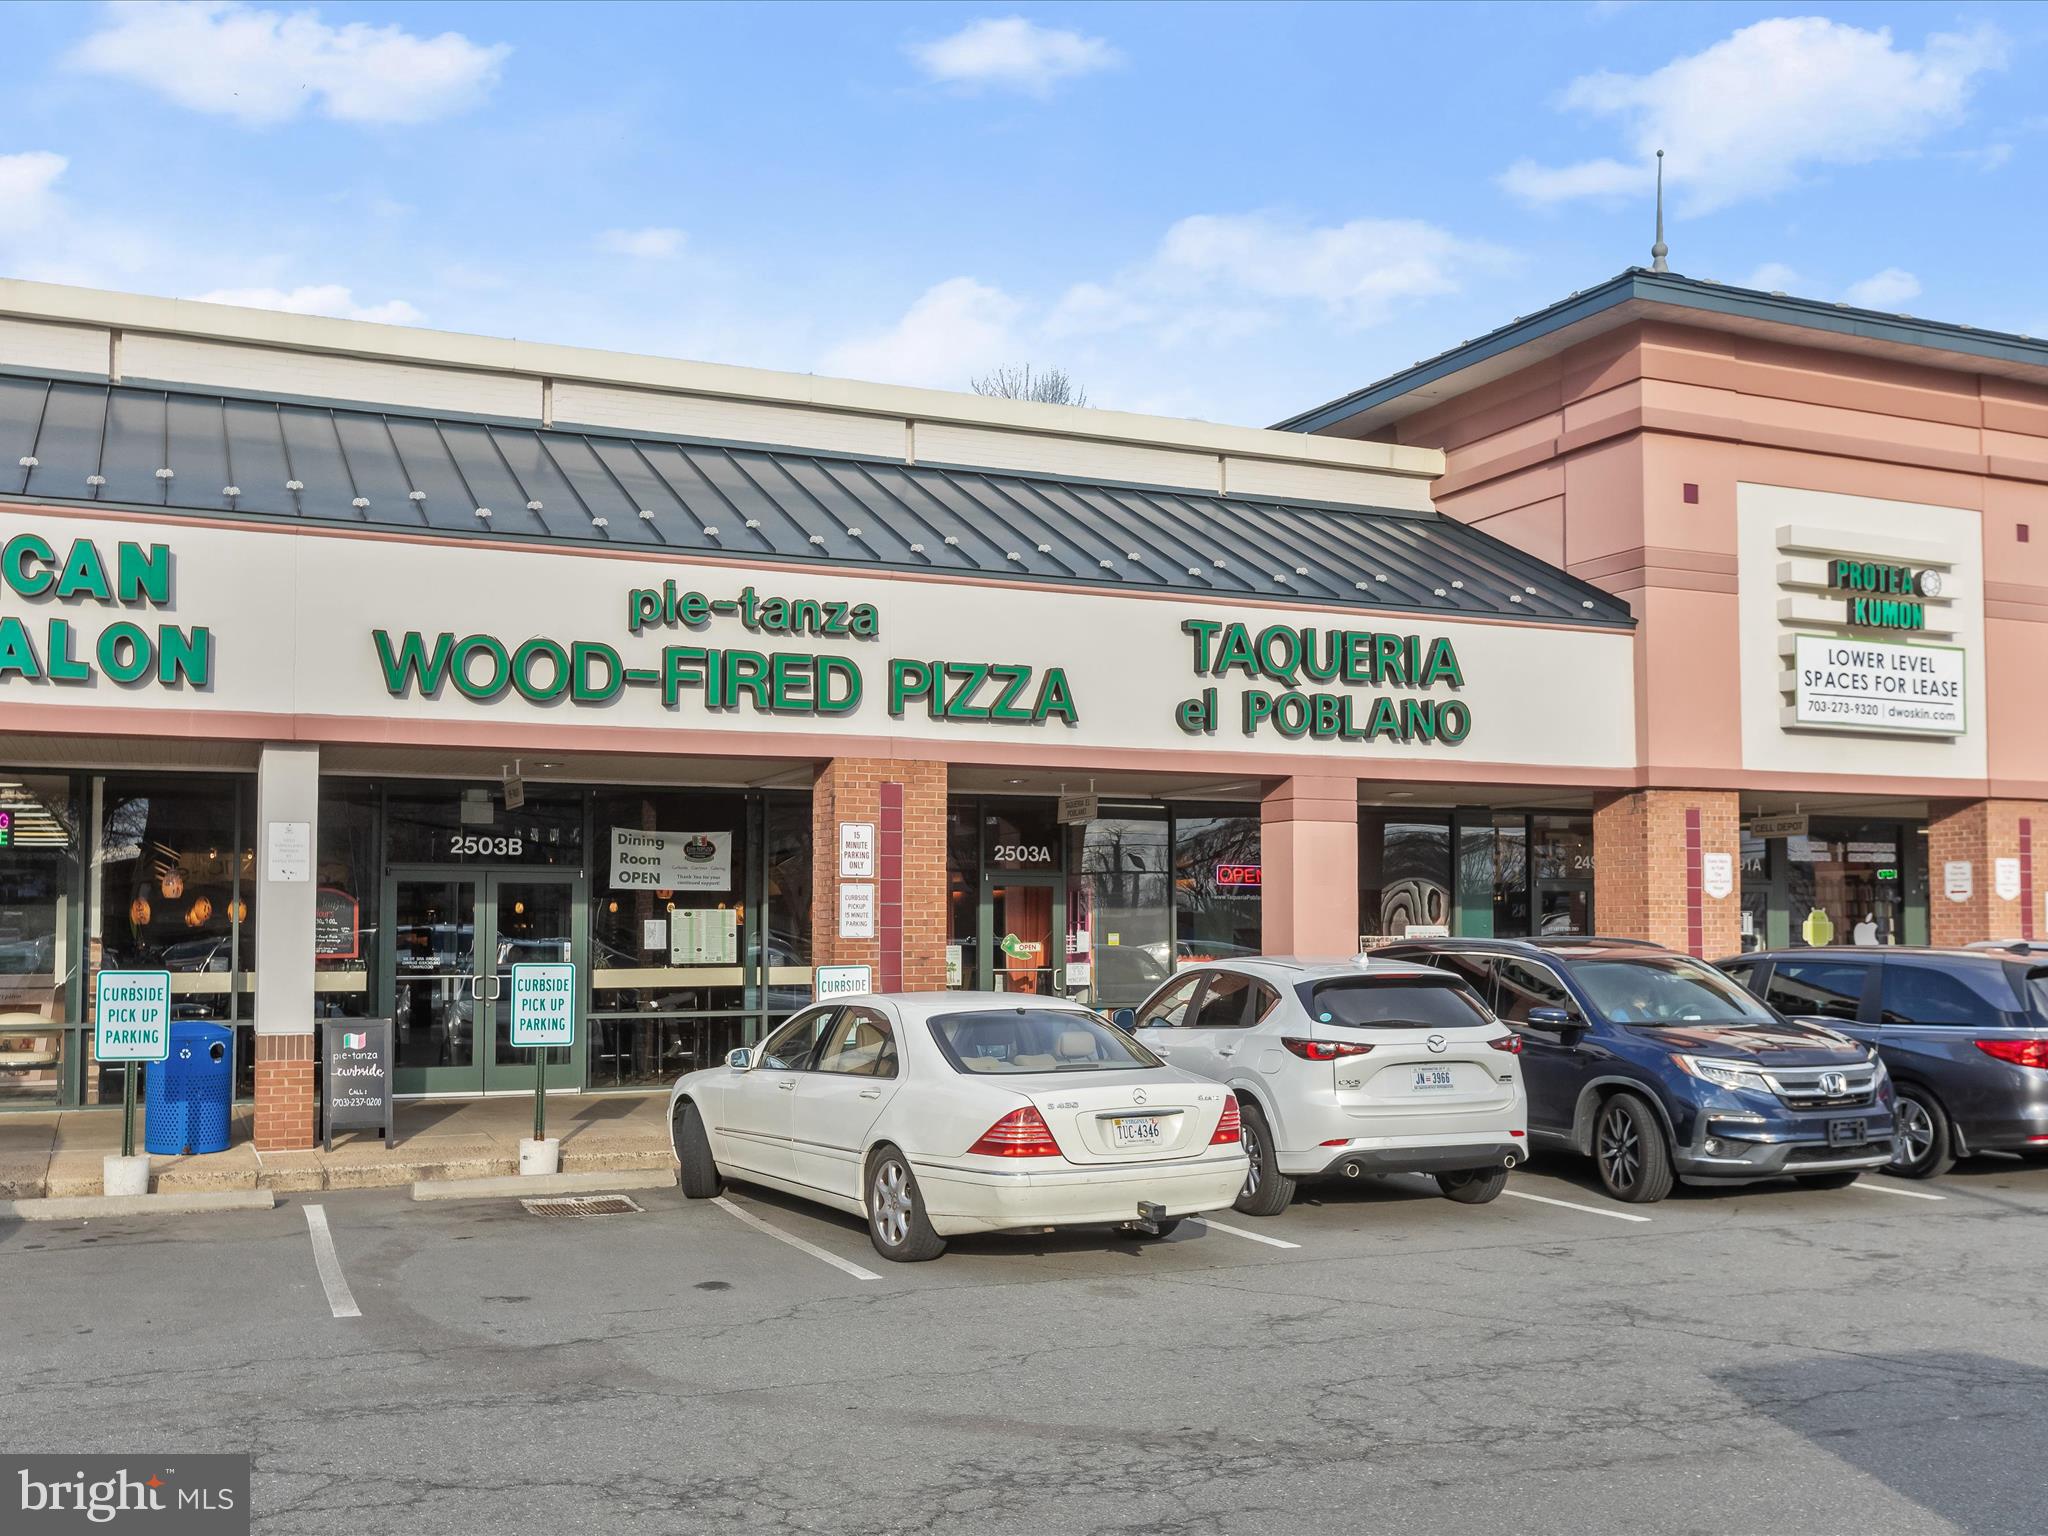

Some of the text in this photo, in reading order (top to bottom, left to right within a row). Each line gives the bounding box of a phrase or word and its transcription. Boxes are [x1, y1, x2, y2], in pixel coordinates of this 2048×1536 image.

[1828, 559, 1915, 595] PROTEA
[629, 579, 879, 635] pie-tanza
[1847, 598, 1925, 631] KUMON
[1181, 619, 1465, 686] TAQUERIA
[1828, 649, 1935, 674] LOWER LEVEL
[372, 629, 1079, 723] WOOD-FIRED PIZZA
[1804, 670, 1958, 698] SPACES FOR LEASE
[1176, 687, 1471, 742] el POBLANO
[1808, 700, 1956, 721] 703-273-9320 dwoskin.com
[1755, 821, 1803, 832] CELL DEPOT
[618, 833, 664, 850] Dining
[853, 831, 861, 839] 15
[450, 836, 523, 855] 2503B
[845, 841, 868, 849] MINUTE
[620, 852, 661, 865] Room
[844, 851, 870, 859] PARKING
[994, 845, 1050, 862] 2503A
[849, 861, 864, 870] ONLY
[619, 871, 661, 884] OPEN
[518, 978, 569, 991] CURBSIDE
[822, 979, 867, 993] CURBSIDE
[103, 987, 164, 1002] CURBSIDE
[522, 998, 565, 1011] PICK UP
[108, 1009, 158, 1023] PICK UP
[520, 1018, 565, 1031] PARKING
[106, 1029, 159, 1044] PARKING
[333, 1052, 378, 1064] pie-tanza
[331, 1064, 384, 1078] curbside
[1416, 1072, 1450, 1084] JN 3966
[1125, 1117, 1149, 1126] VIRGINIA
